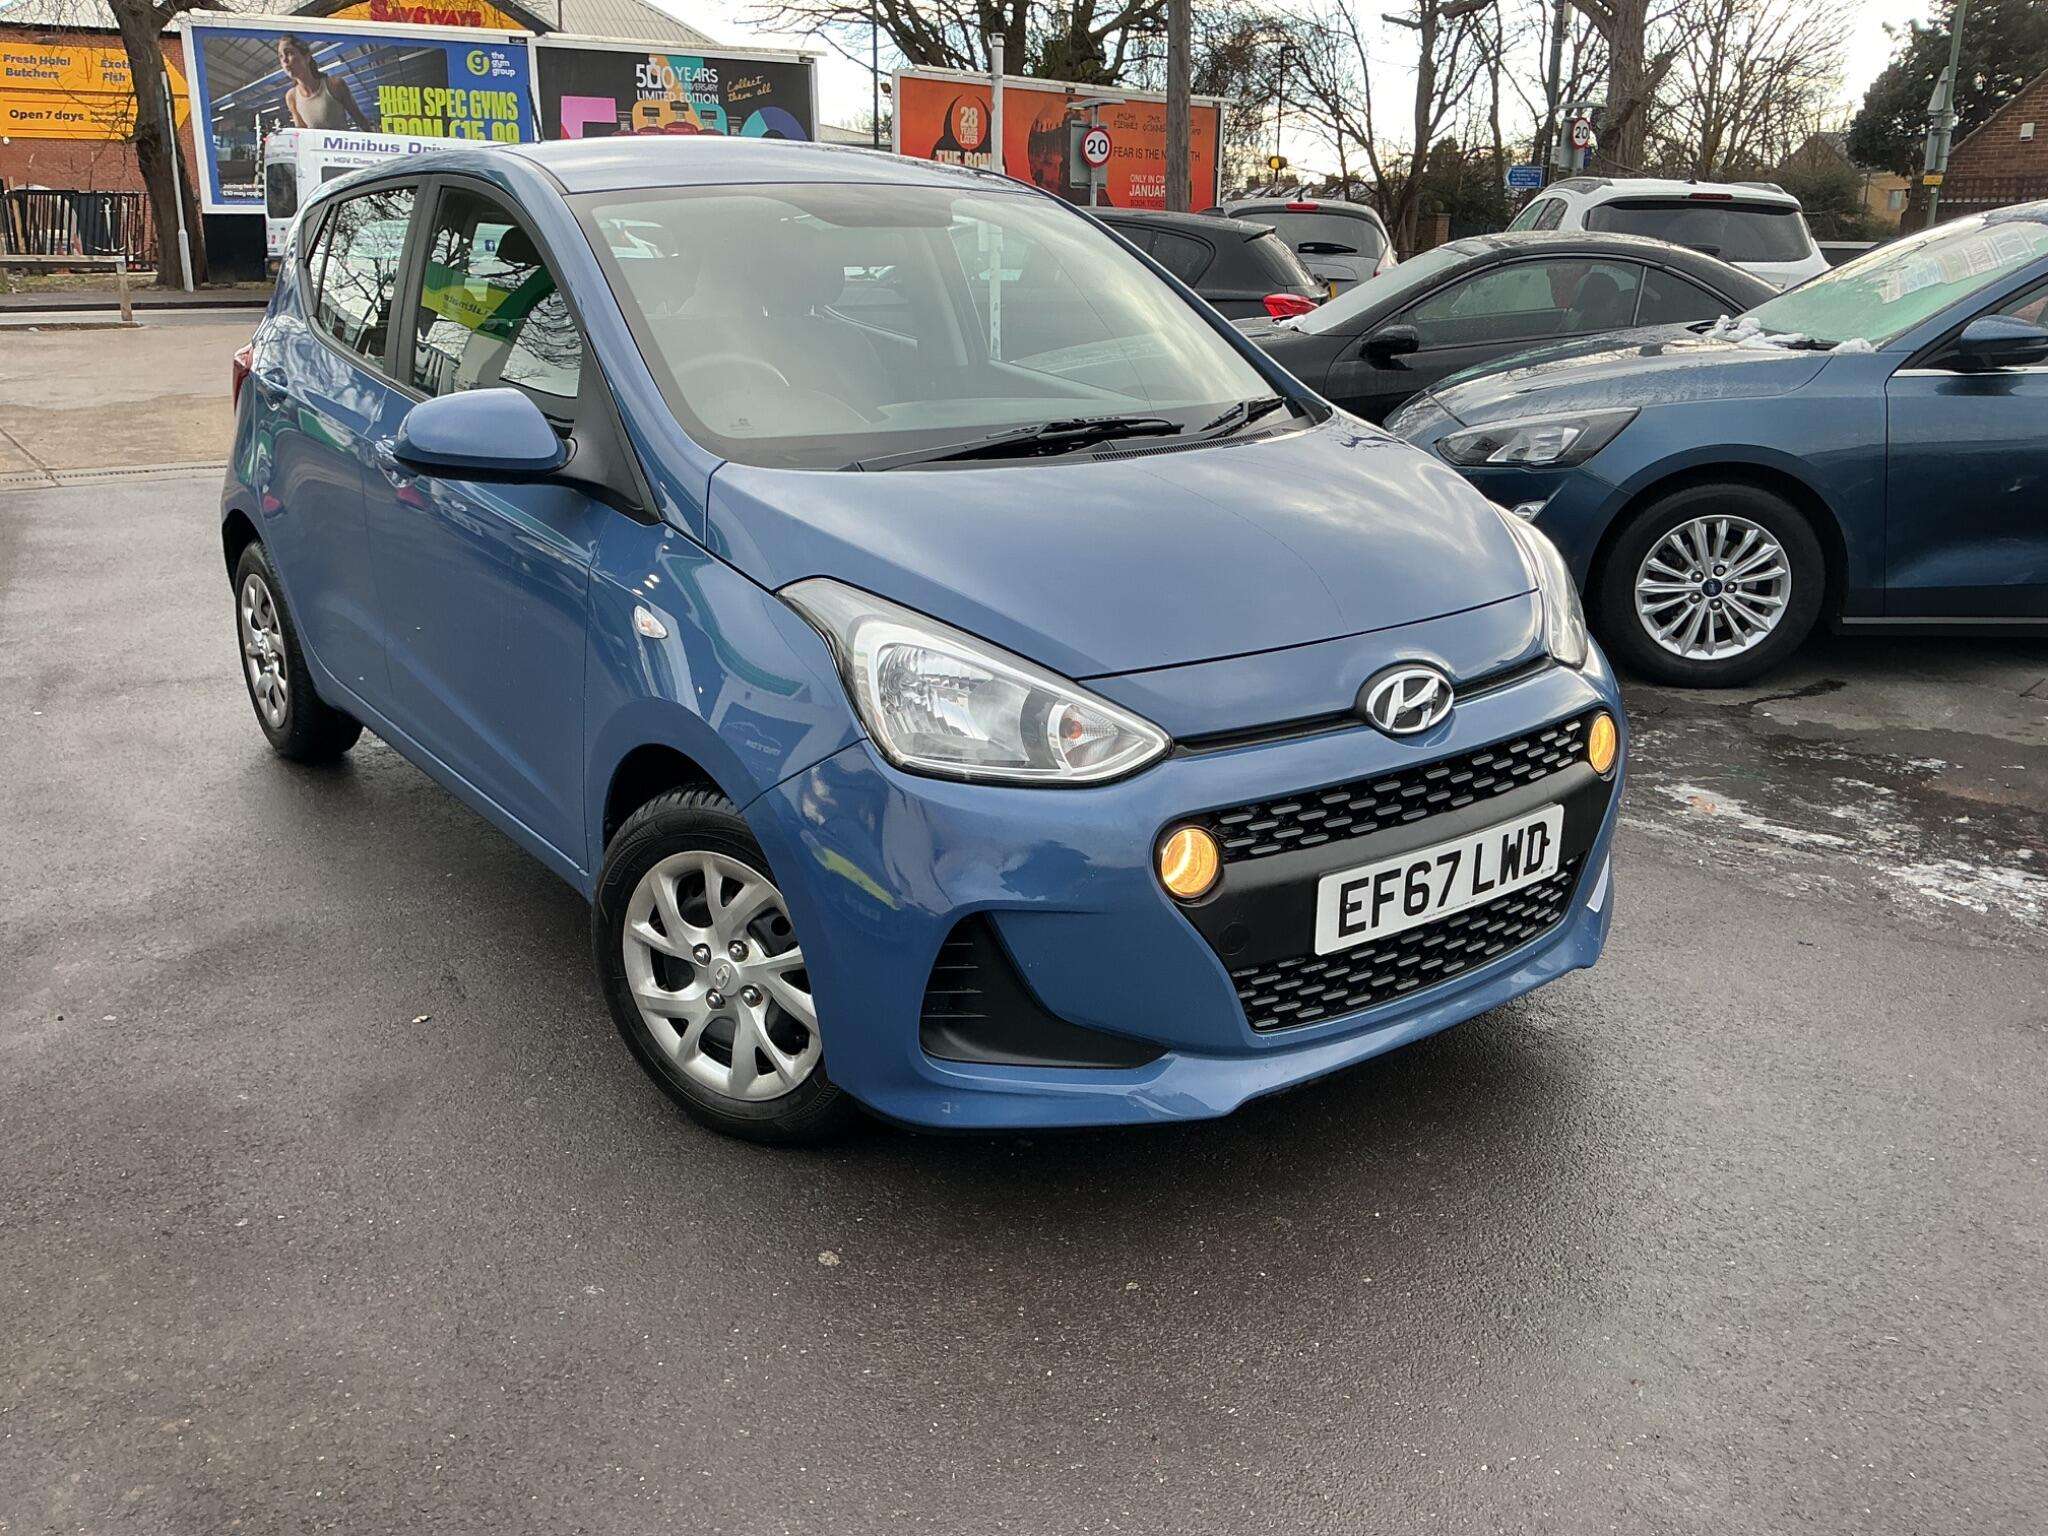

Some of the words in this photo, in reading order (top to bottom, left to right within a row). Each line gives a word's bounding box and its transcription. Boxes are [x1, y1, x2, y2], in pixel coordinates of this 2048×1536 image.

[3, 54, 36, 65] Fresh
[491, 52, 505, 60] the
[101, 59, 130, 70] Exot
[491, 60, 510, 68] gym
[5, 67, 60, 80] Butchers
[102, 72, 126, 83] Fish
[491, 68, 516, 78] group
[675, 66, 719, 84] YEARS
[726, 75, 764, 93] Collect
[757, 84, 772, 97] all
[379, 86, 421, 117] HIGH
[424, 88, 467, 118] SPEC
[469, 90, 518, 121] GYMS
[636, 91, 676, 102] LIMITED
[680, 92, 719, 105] EDITION
[9, 109, 43, 120] Open
[44, 111, 52, 119] 7
[54, 111, 85, 122] days
[960, 107, 979, 128] 28
[1575, 126, 1588, 140] 20
[323, 137, 400, 153] Minibus
[1087, 139, 1108, 155] 20
[1113, 146, 1133, 158] FEAR
[1135, 148, 1143, 159] IS
[1145, 149, 1160, 160] THE
[1130, 174, 1146, 183] ONLY
[1148, 175, 1156, 183] IN
[1129, 185, 1165, 198] JANUAR
[1338, 850, 1462, 938] EF67
[1471, 821, 1550, 896] LWD
